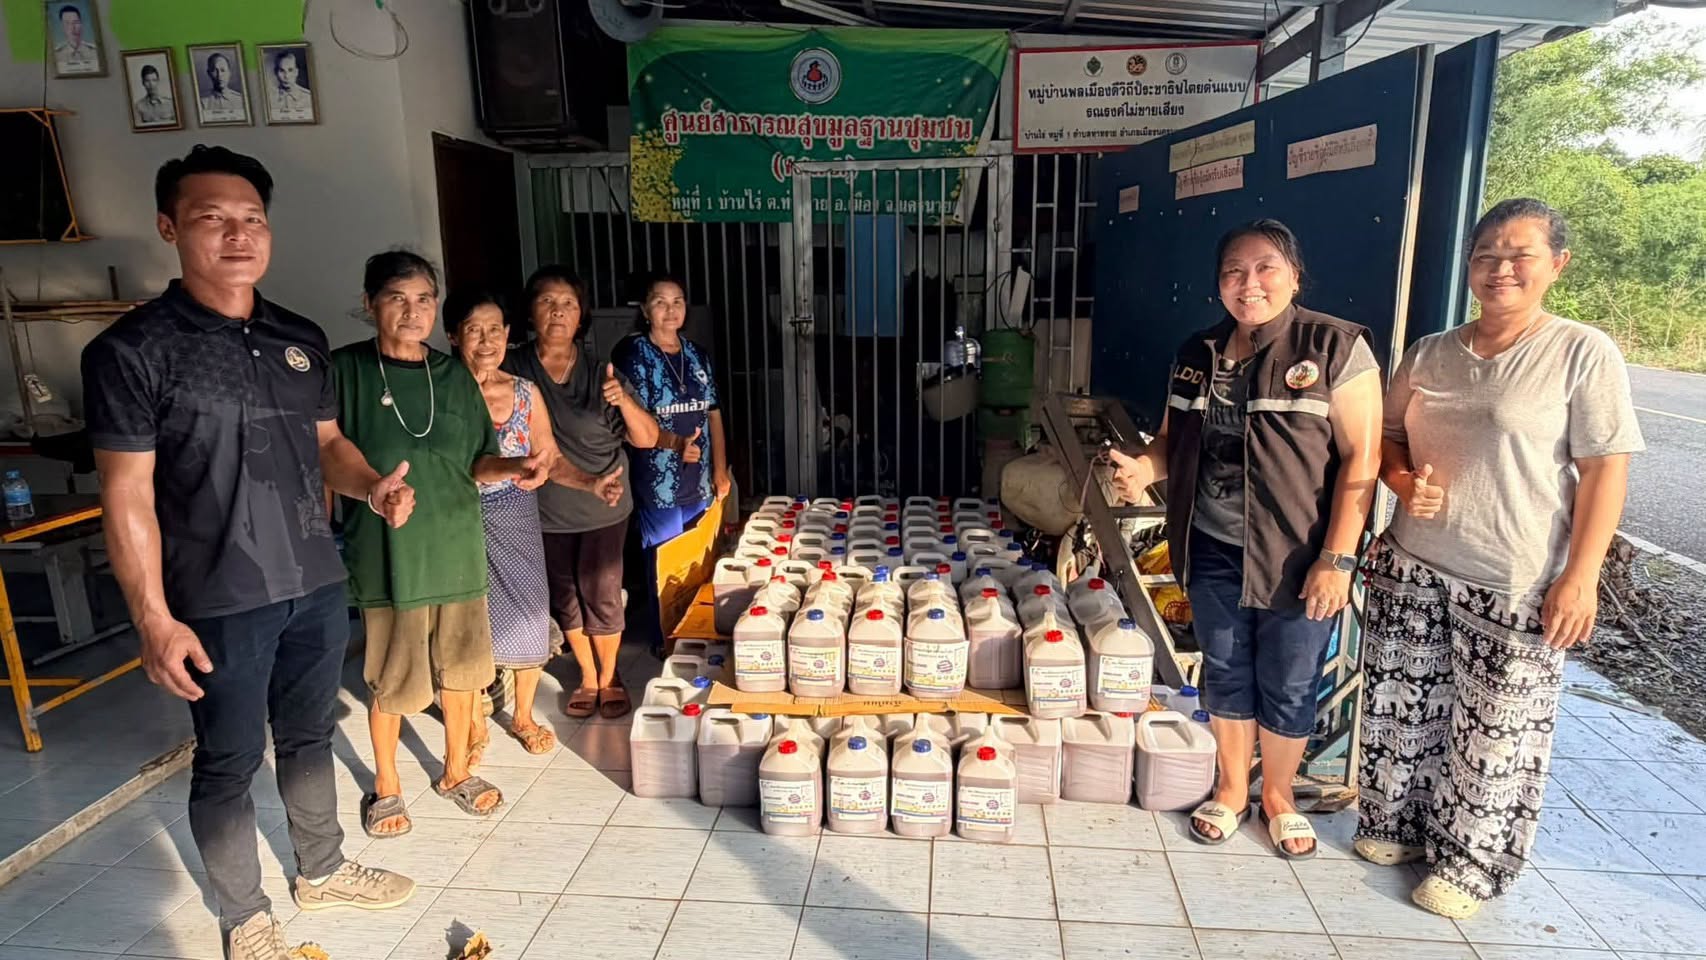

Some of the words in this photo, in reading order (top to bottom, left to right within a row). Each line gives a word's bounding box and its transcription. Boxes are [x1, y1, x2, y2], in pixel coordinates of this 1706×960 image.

[662, 99, 972, 150] ศูนย์สาธารณสุขมูลฐานชุมชน
[1086, 101, 1185, 118] รณรงค์ไม่ขายเสียง
[672, 184, 700, 216] หมู่ที่
[706, 197, 713, 211] 1
[719, 188, 763, 211] บ้านไร่
